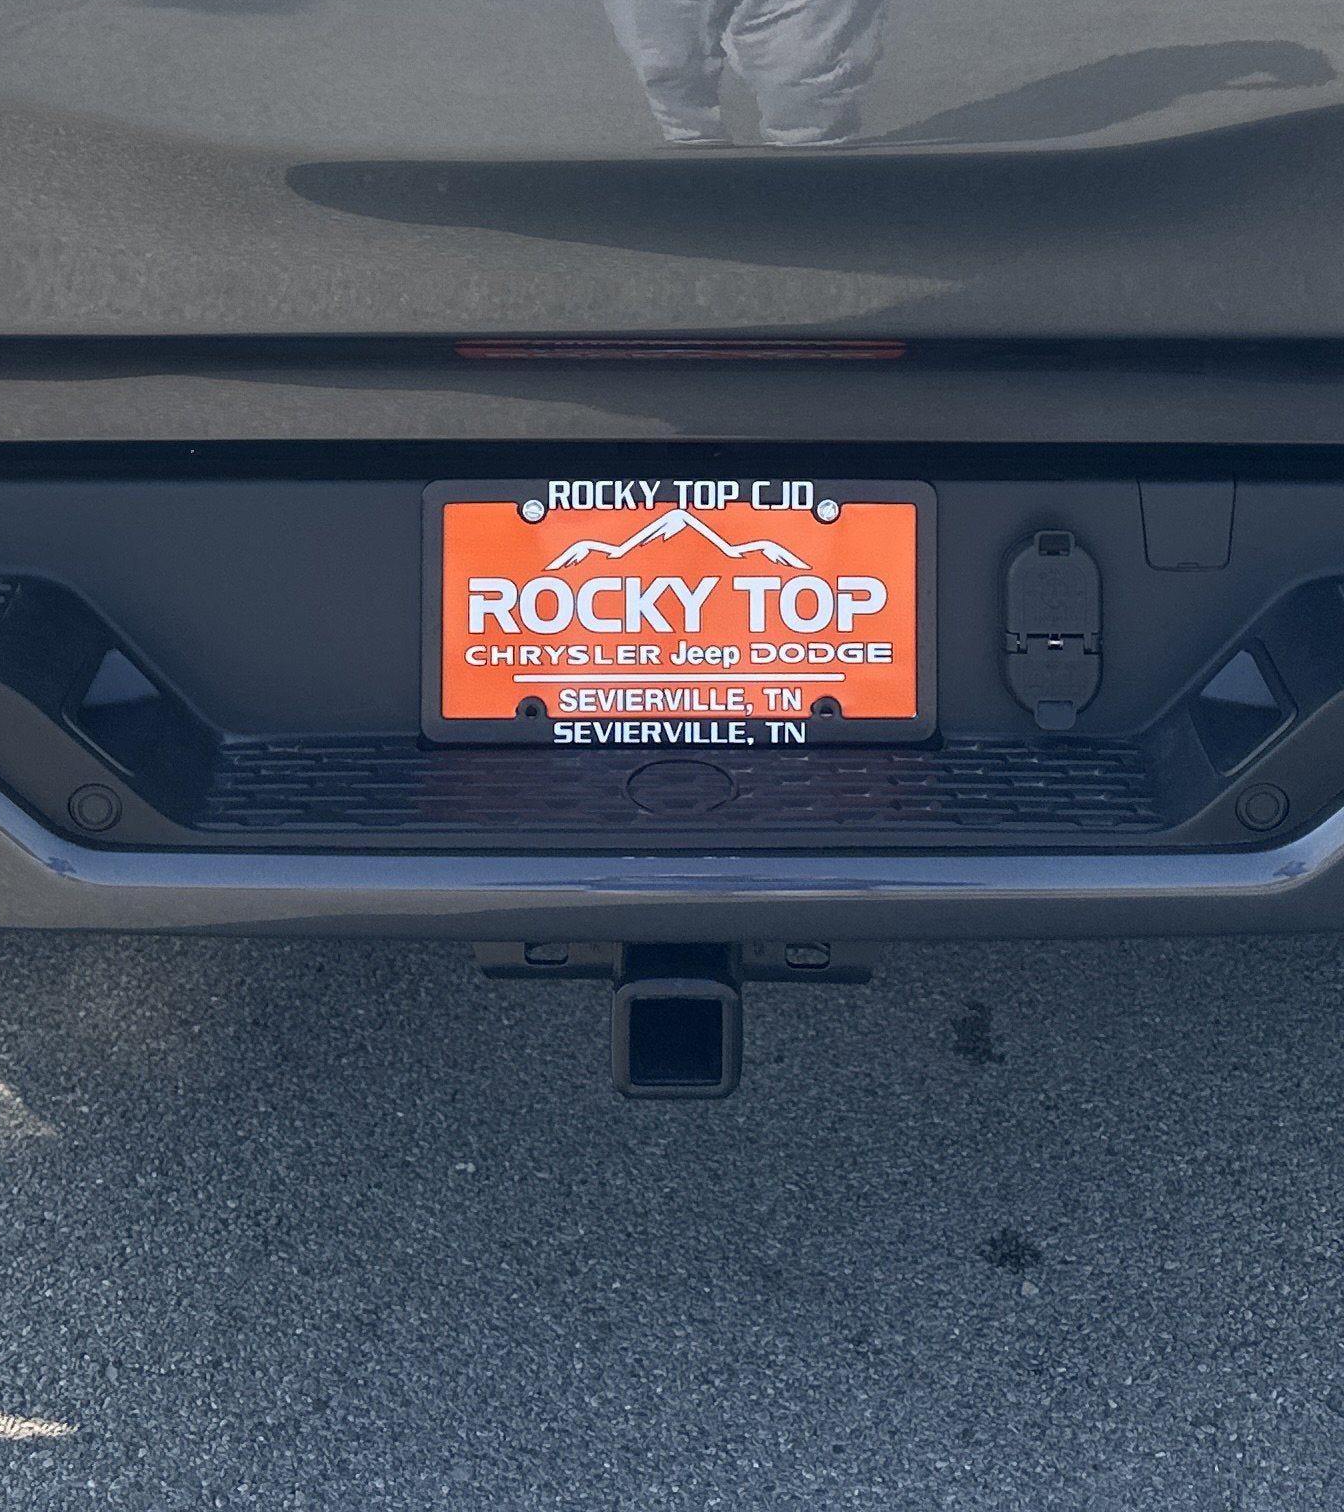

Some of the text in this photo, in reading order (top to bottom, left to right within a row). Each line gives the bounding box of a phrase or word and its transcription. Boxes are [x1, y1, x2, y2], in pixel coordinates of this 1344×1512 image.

[548, 481, 814, 510] ROCKY TOP CJD
[468, 575, 888, 635] ROCKY TOP
[464, 640, 893, 669] CHRYSLER Jeep DODGE
[558, 688, 803, 716] SEVIERVILLE, TN
[552, 721, 807, 746] SEVIERVILLE, TN
